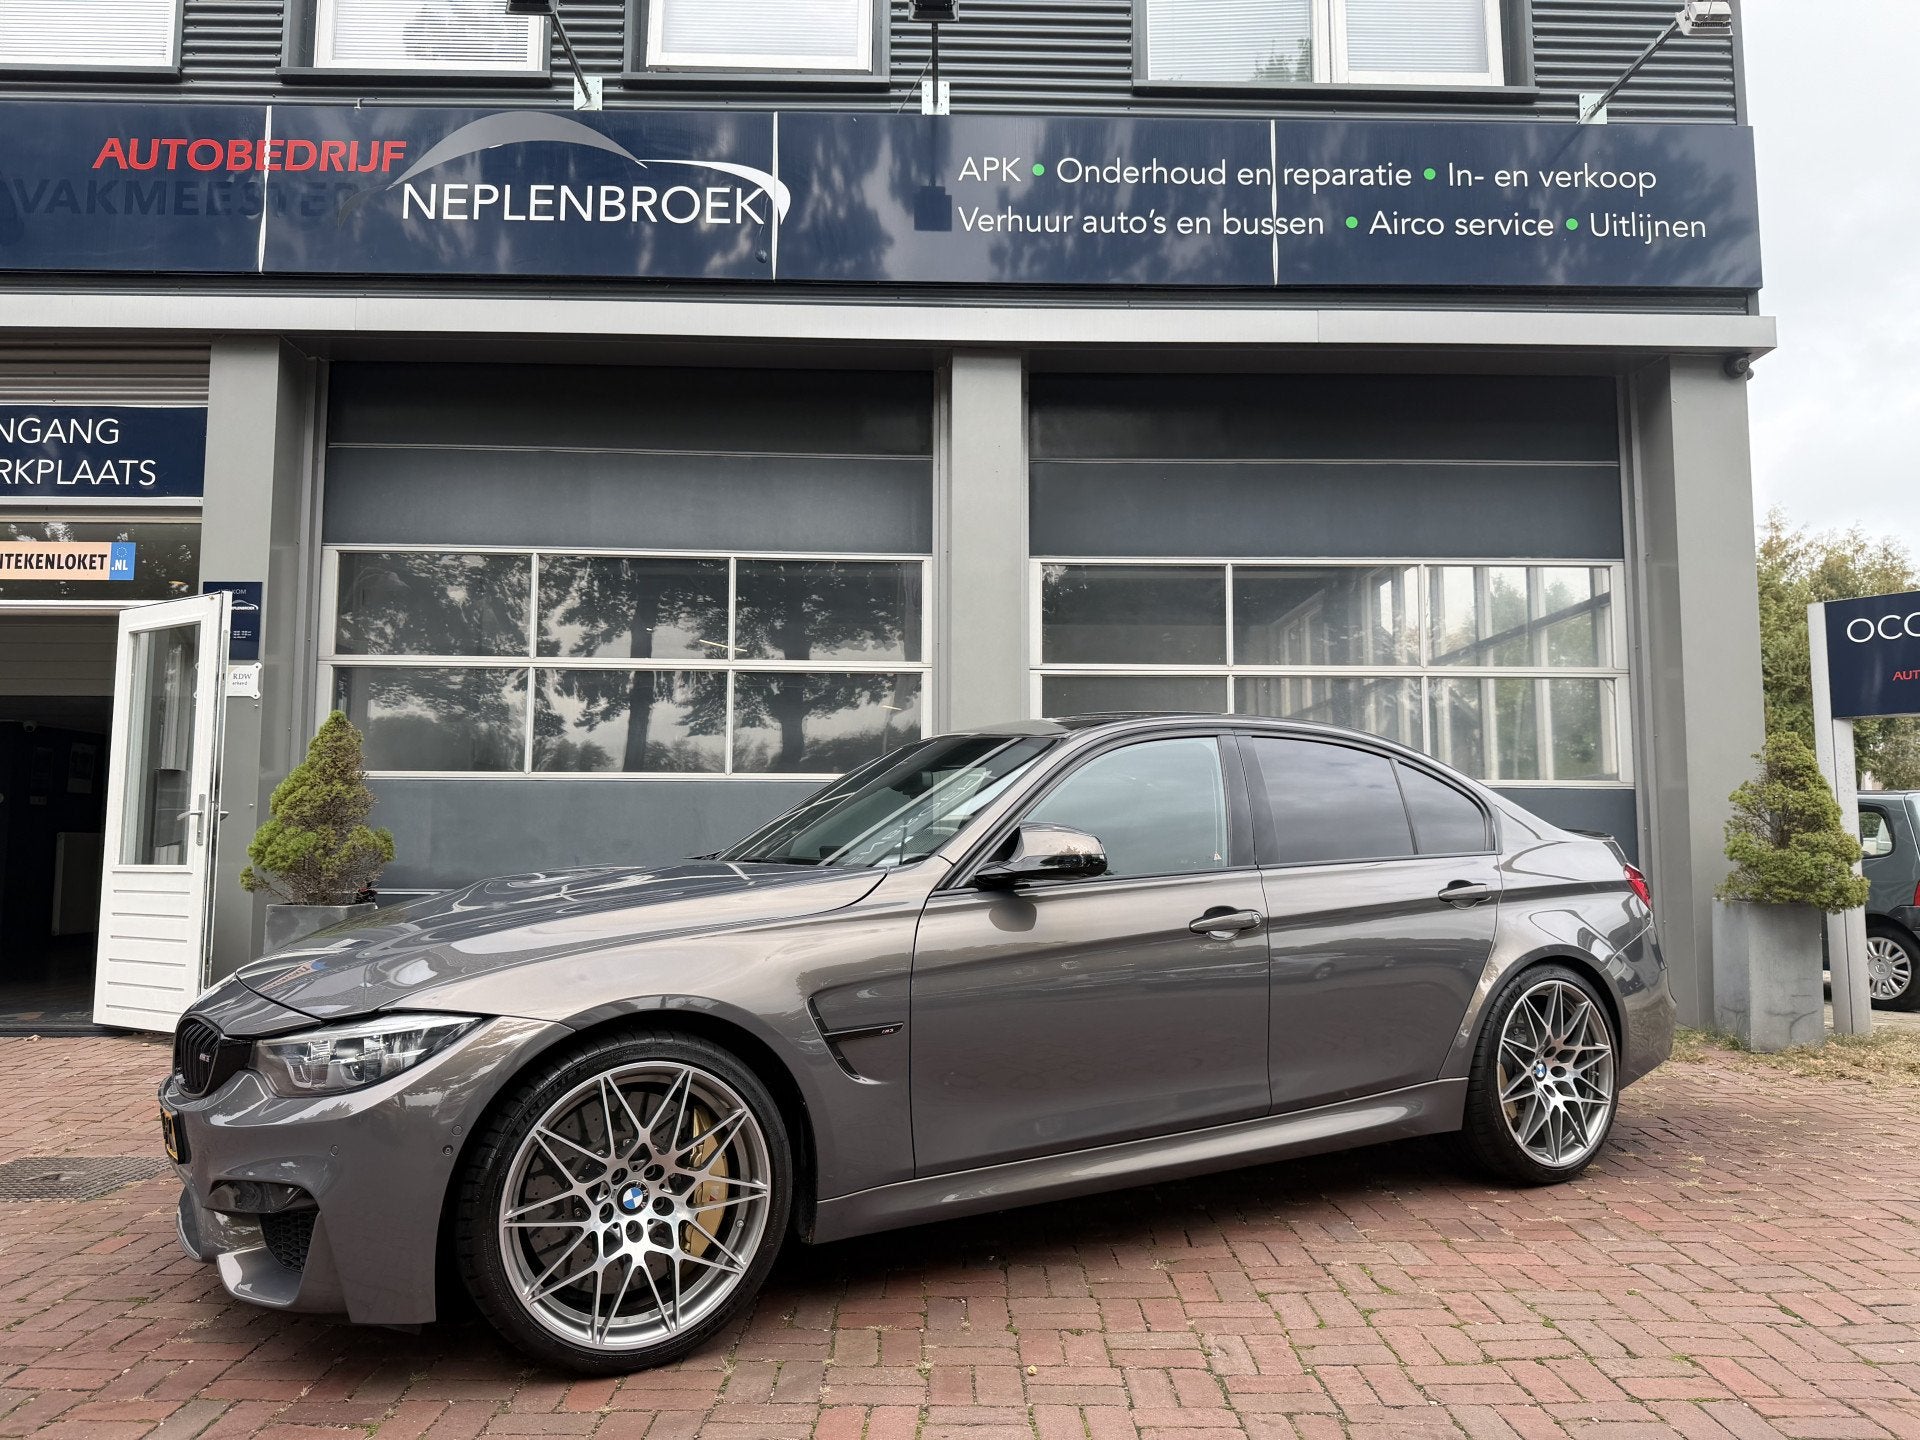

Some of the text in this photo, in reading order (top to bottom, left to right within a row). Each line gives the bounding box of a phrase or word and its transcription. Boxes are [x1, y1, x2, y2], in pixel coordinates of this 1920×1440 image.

[92, 137, 407, 172] AUTOBEDRIJF
[957, 156, 1657, 198] APK Onderhoud en reparatie In- en verkoop
[402, 183, 765, 225] NEPLENBROEK
[957, 205, 1074, 233] Verhuur
[1176, 215, 1211, 235] en
[1222, 208, 1325, 236] bussen
[1368, 210, 1445, 236] Airco
[1454, 212, 1554, 237] service
[1589, 212, 1707, 245] Uitlijnen
[0, 553, 108, 570] TEKENLOKET
